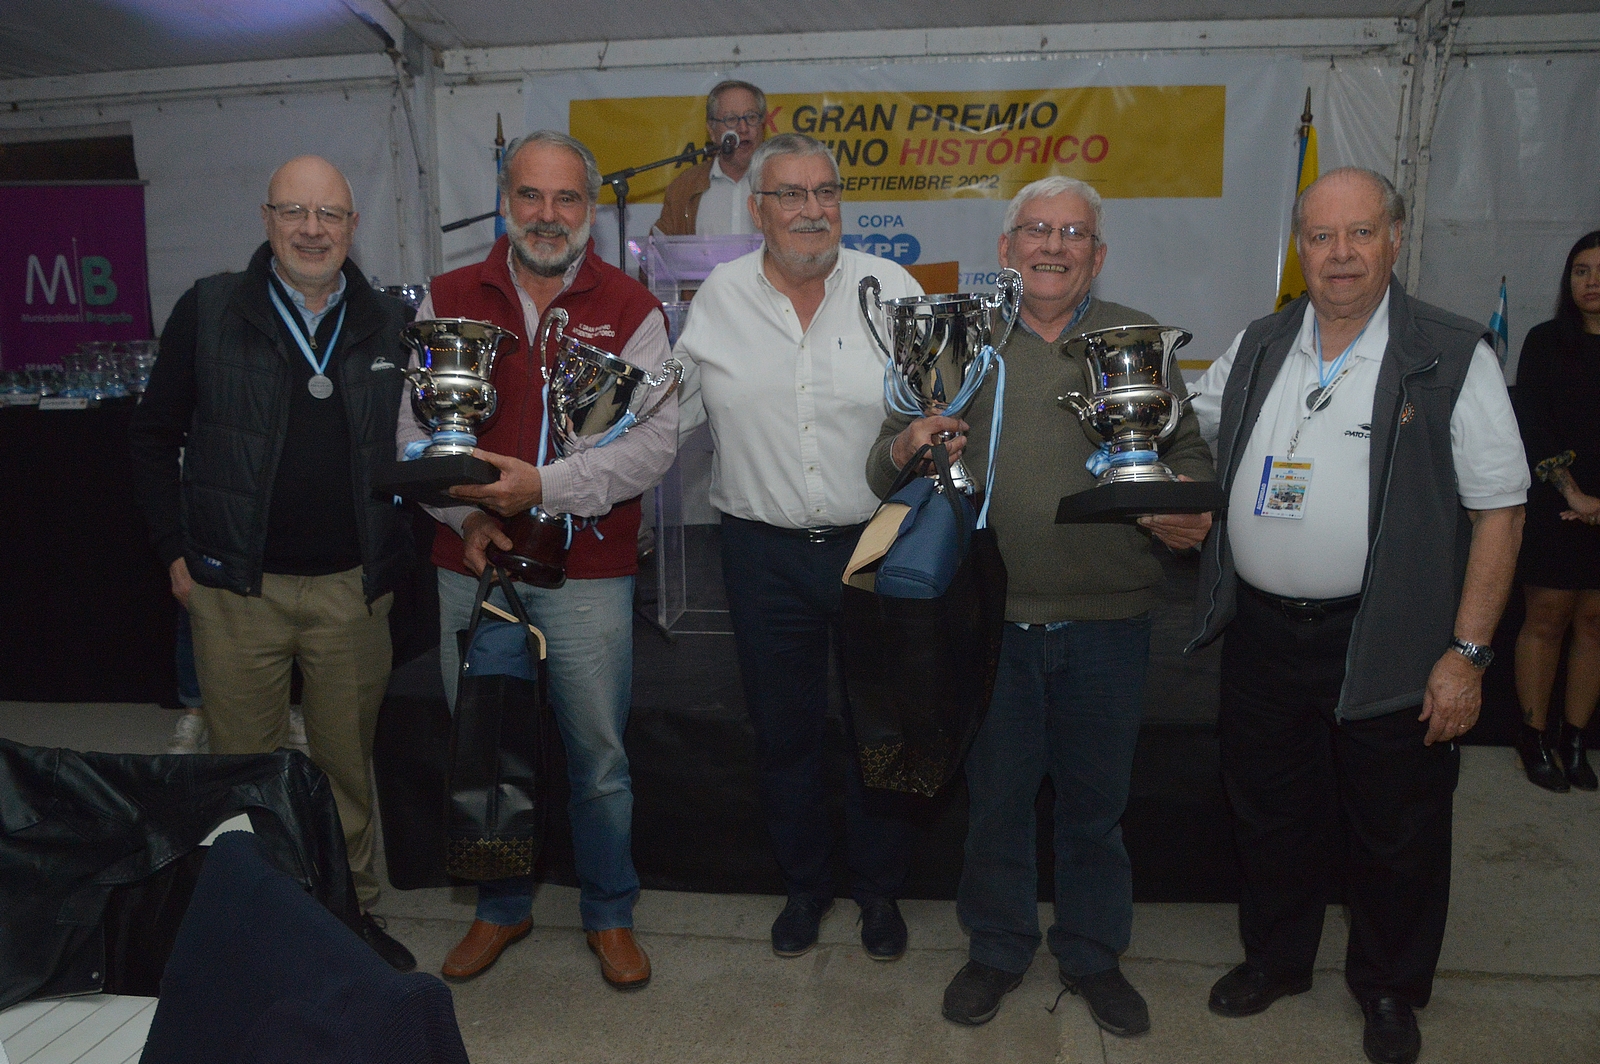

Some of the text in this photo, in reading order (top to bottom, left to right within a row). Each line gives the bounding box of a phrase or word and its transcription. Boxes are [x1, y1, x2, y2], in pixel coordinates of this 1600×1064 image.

[792, 103, 898, 133] GRAN
[906, 101, 1058, 132] PREMIO
[898, 131, 1110, 167] HISTÓRICO
[839, 174, 1000, 191] SEPTIEMBRE 2022
[857, 214, 904, 228] COPA
[854, 242, 910, 258] YPF
